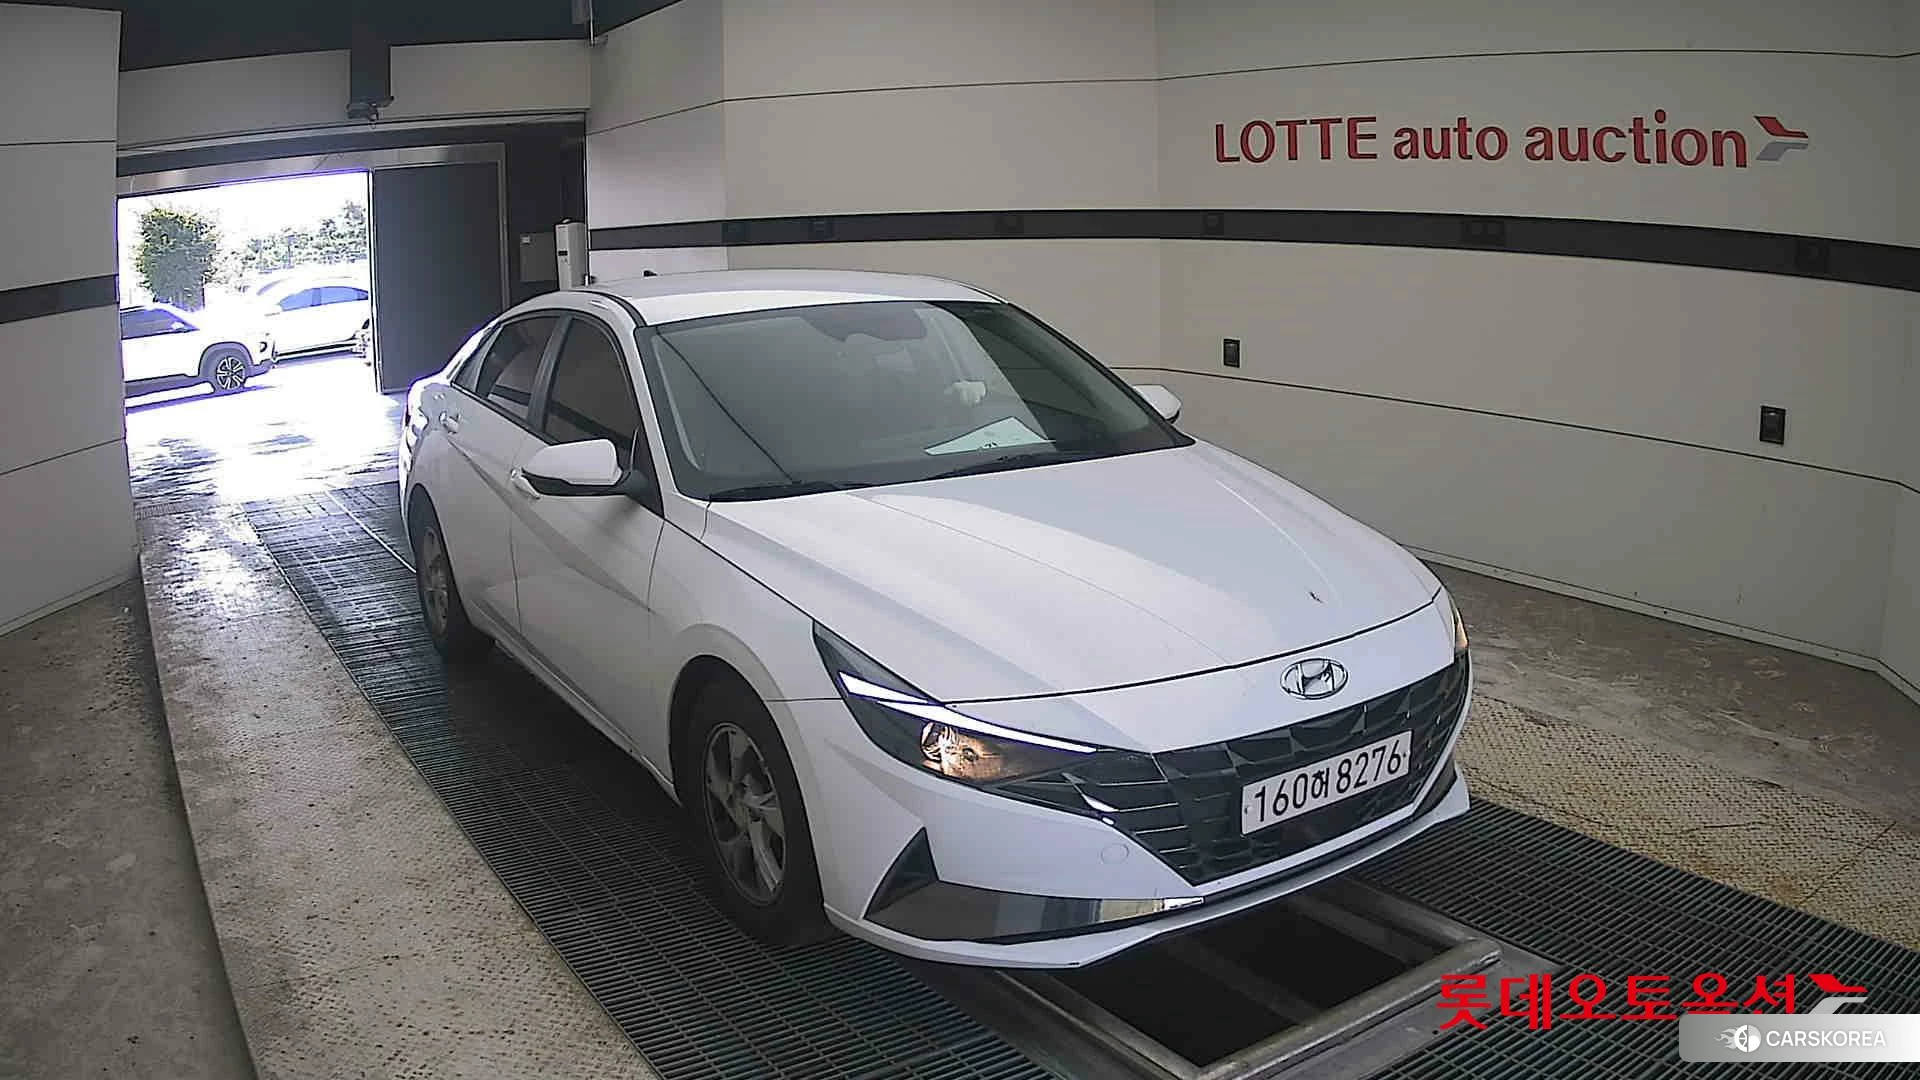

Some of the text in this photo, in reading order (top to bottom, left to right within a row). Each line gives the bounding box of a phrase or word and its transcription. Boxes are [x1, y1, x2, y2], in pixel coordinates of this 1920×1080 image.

[1215, 109, 1748, 168] LOTTE auto auction
